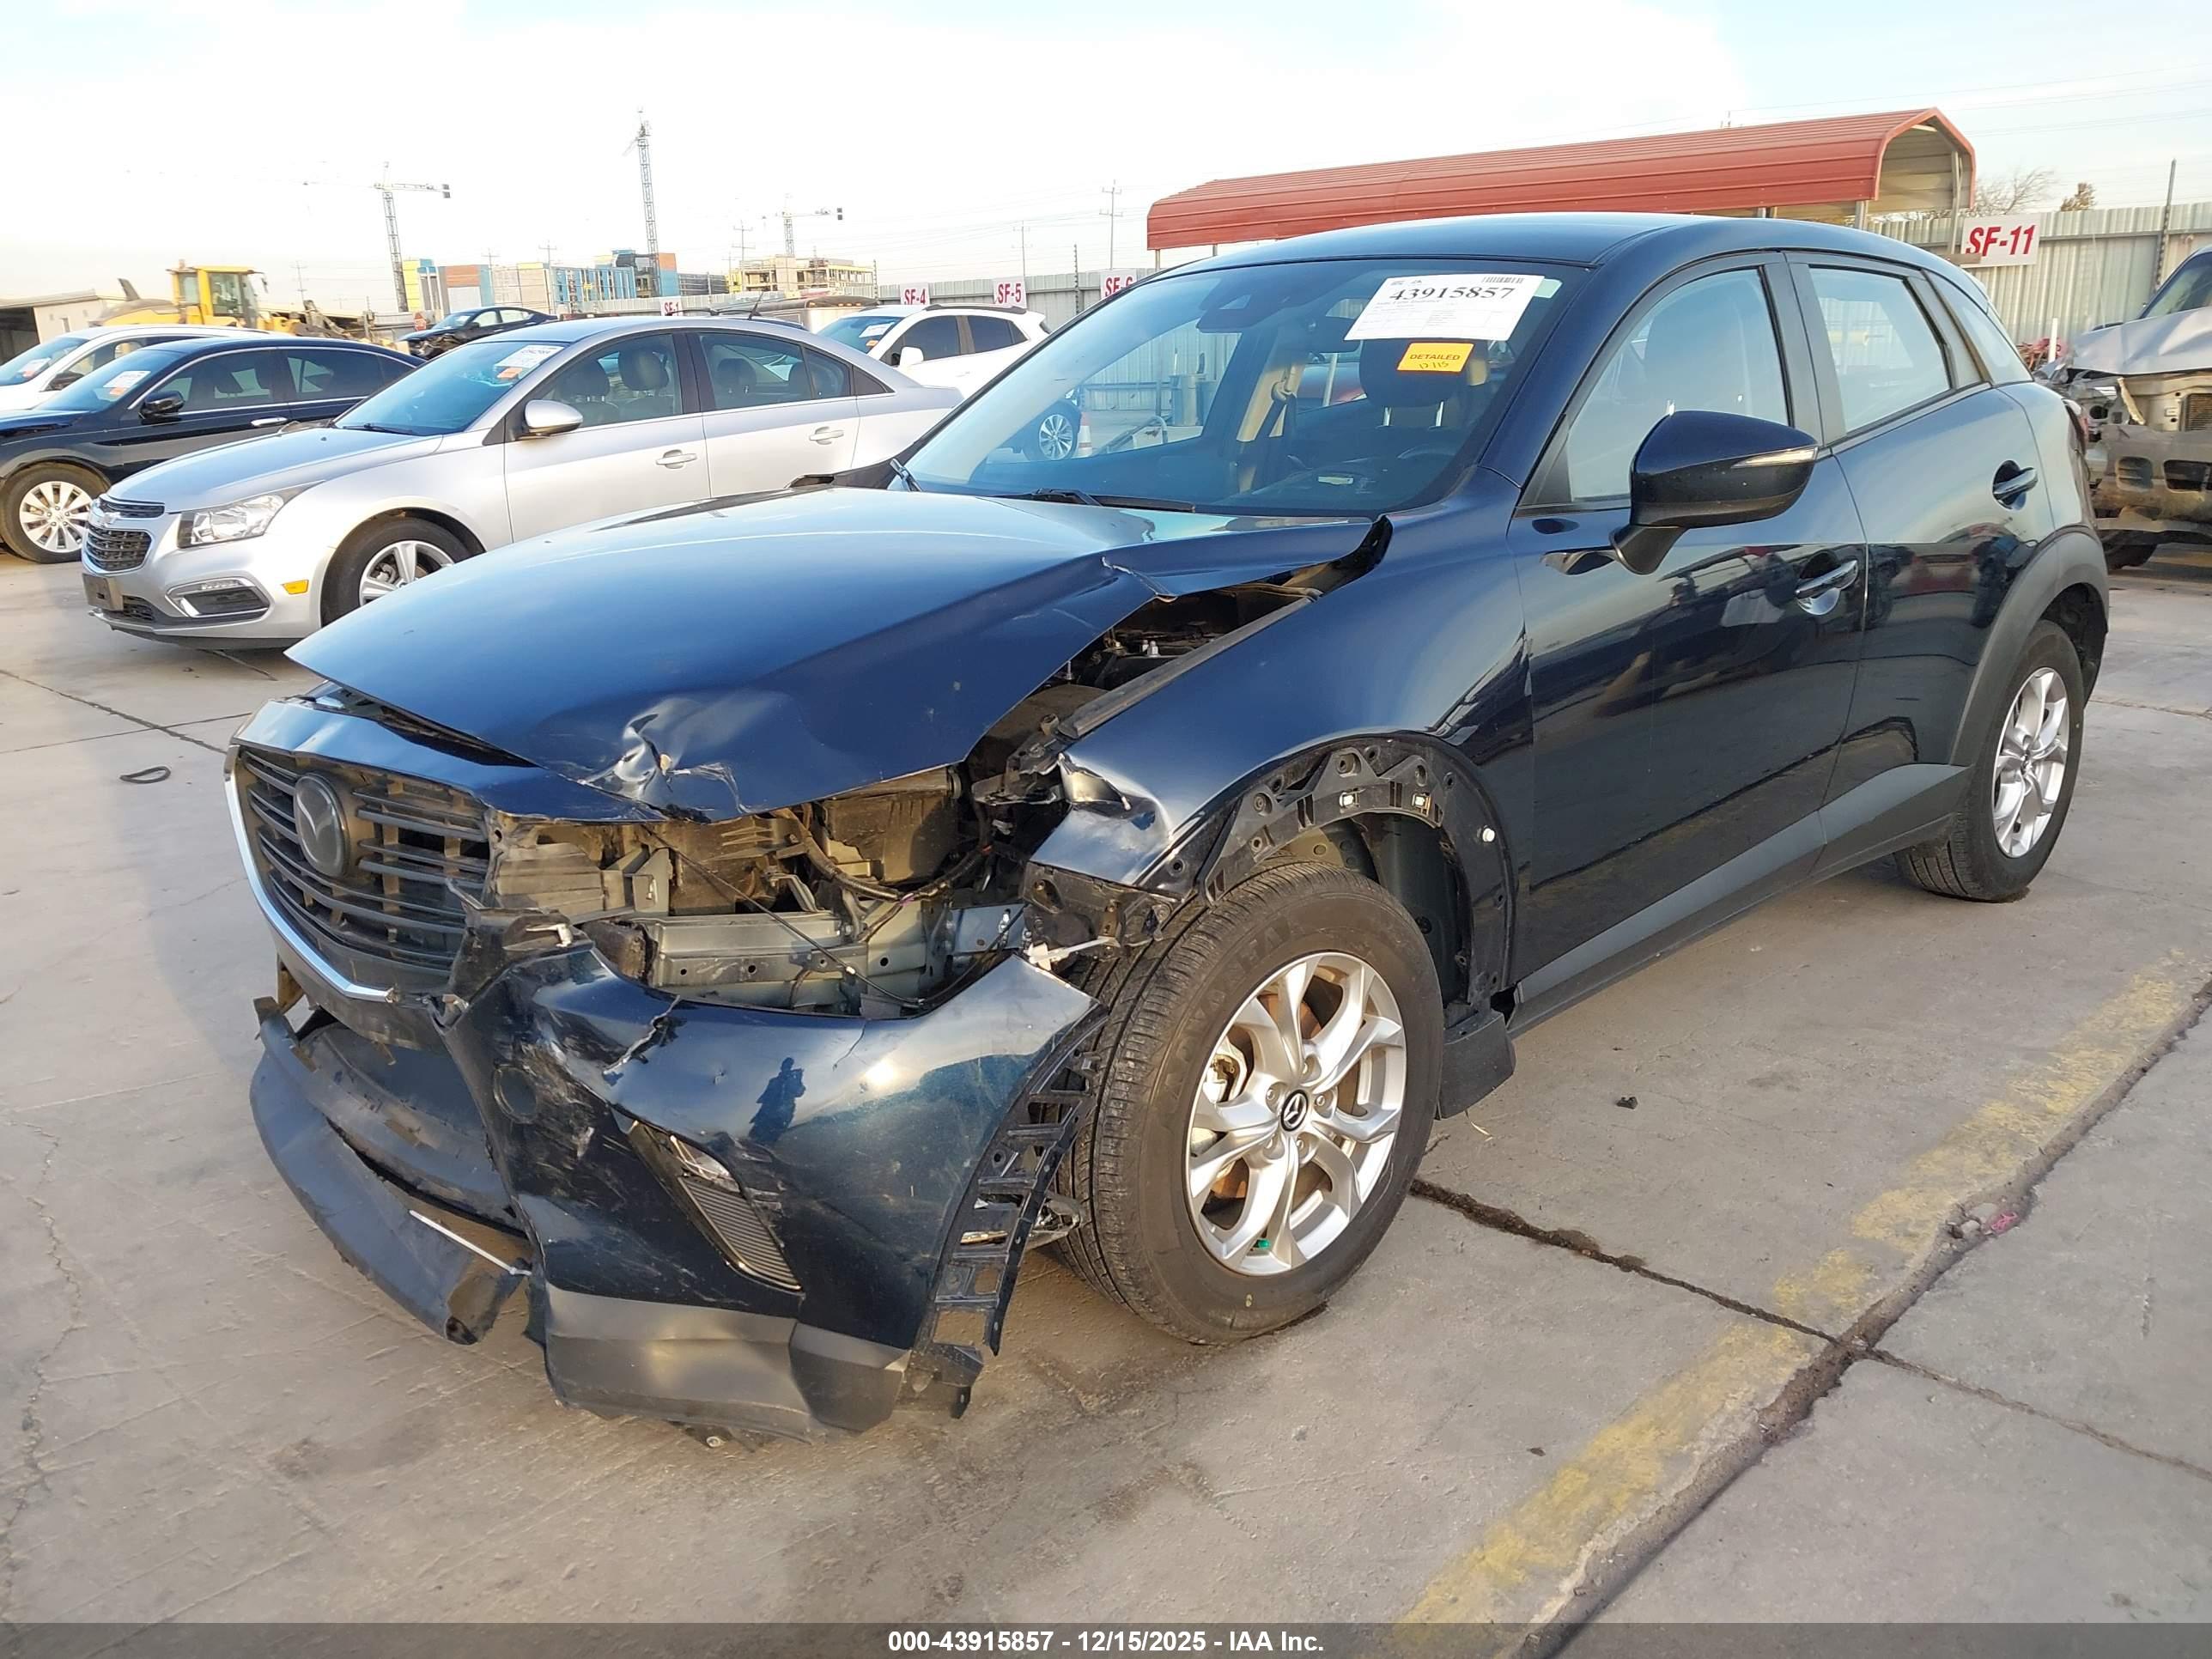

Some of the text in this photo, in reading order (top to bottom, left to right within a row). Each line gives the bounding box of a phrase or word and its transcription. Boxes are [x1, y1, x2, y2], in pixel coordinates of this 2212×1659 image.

[1966, 225, 2036, 257] SF-11
[904, 289, 926, 305] SF-4
[998, 283, 1021, 304] SF-5
[1389, 286, 1515, 301] 43915857
